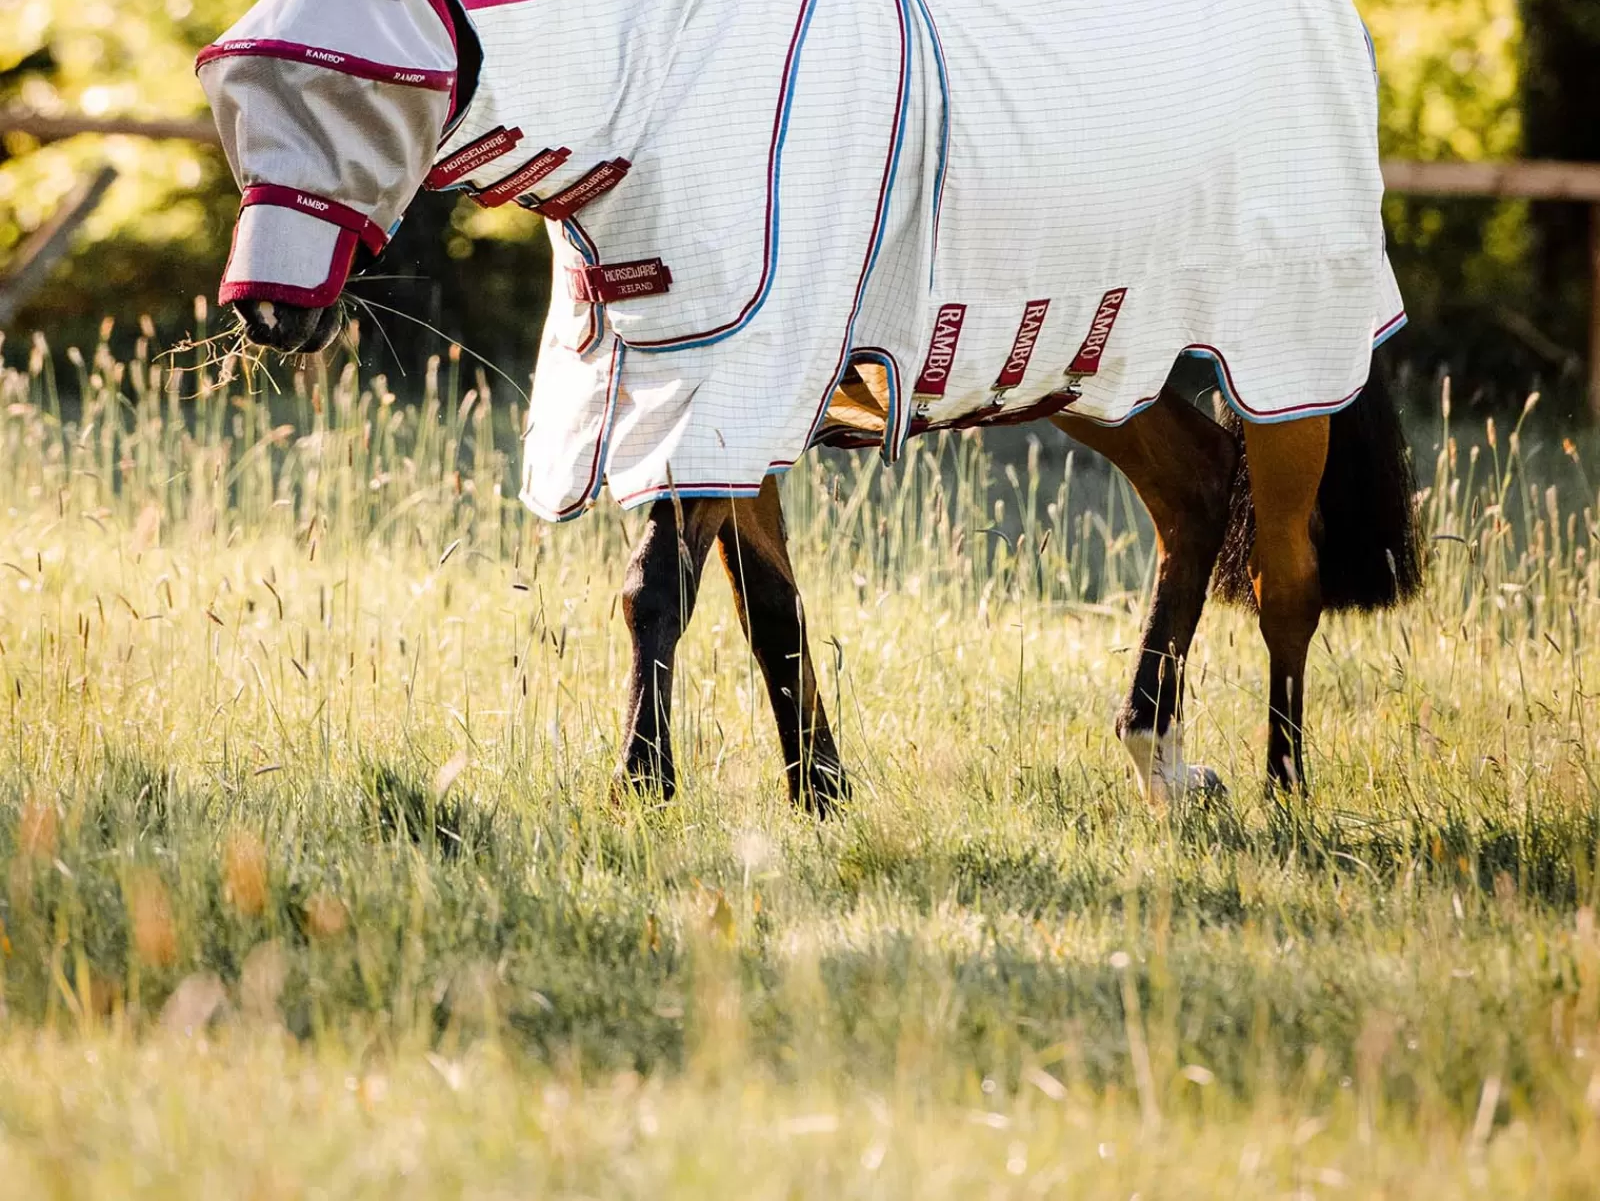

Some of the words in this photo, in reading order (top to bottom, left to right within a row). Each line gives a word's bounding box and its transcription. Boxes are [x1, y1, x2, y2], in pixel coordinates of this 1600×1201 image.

[923, 308, 962, 382] RAMBO
[1006, 303, 1047, 373] RAMBO
[1080, 291, 1124, 359] RAMBO
